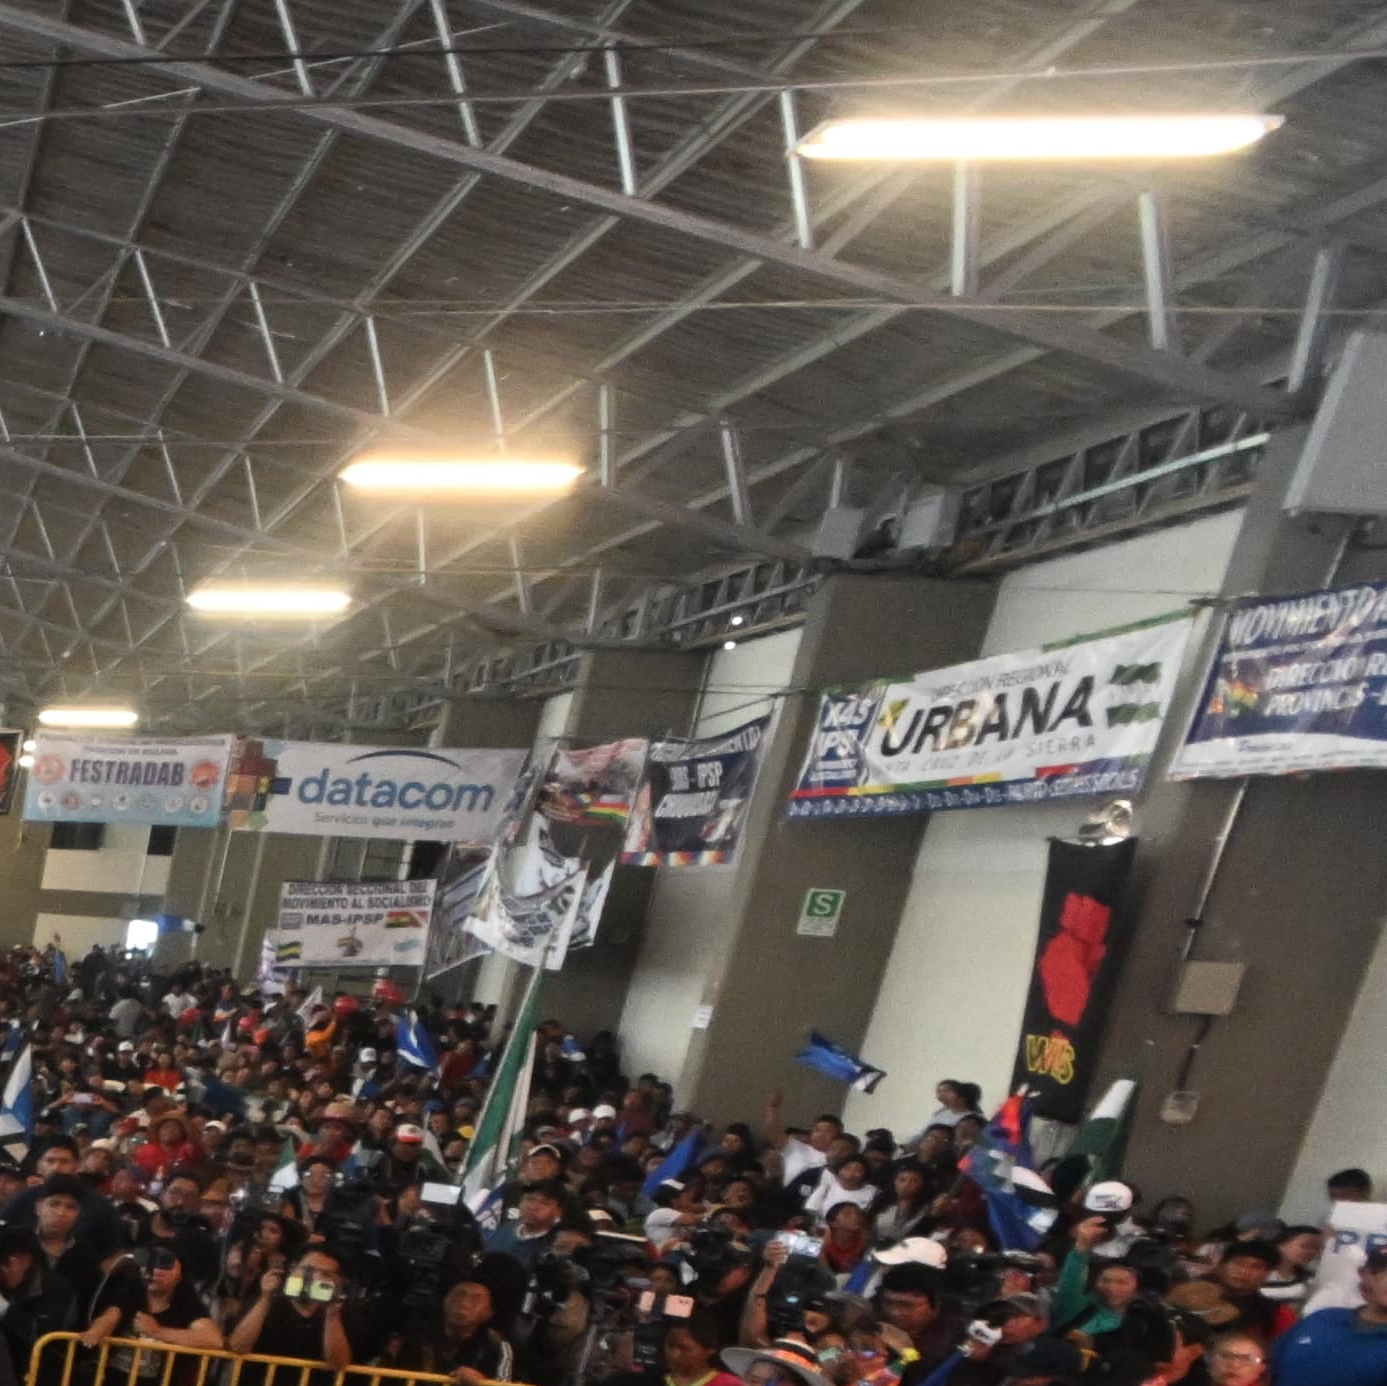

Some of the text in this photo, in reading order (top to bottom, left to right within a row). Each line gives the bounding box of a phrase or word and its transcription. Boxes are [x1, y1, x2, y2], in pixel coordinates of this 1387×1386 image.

[880, 675, 1096, 757] URBANA
[1027, 734, 1096, 758] SIERRA
[69, 758, 187, 787] FESTRADAB
[298, 768, 495, 812] datacom
[282, 896, 349, 910] MOVIMIENTO
[352, 896, 364, 909] AL
[812, 893, 834, 916] S
[306, 912, 385, 925] MAS-IPSP
